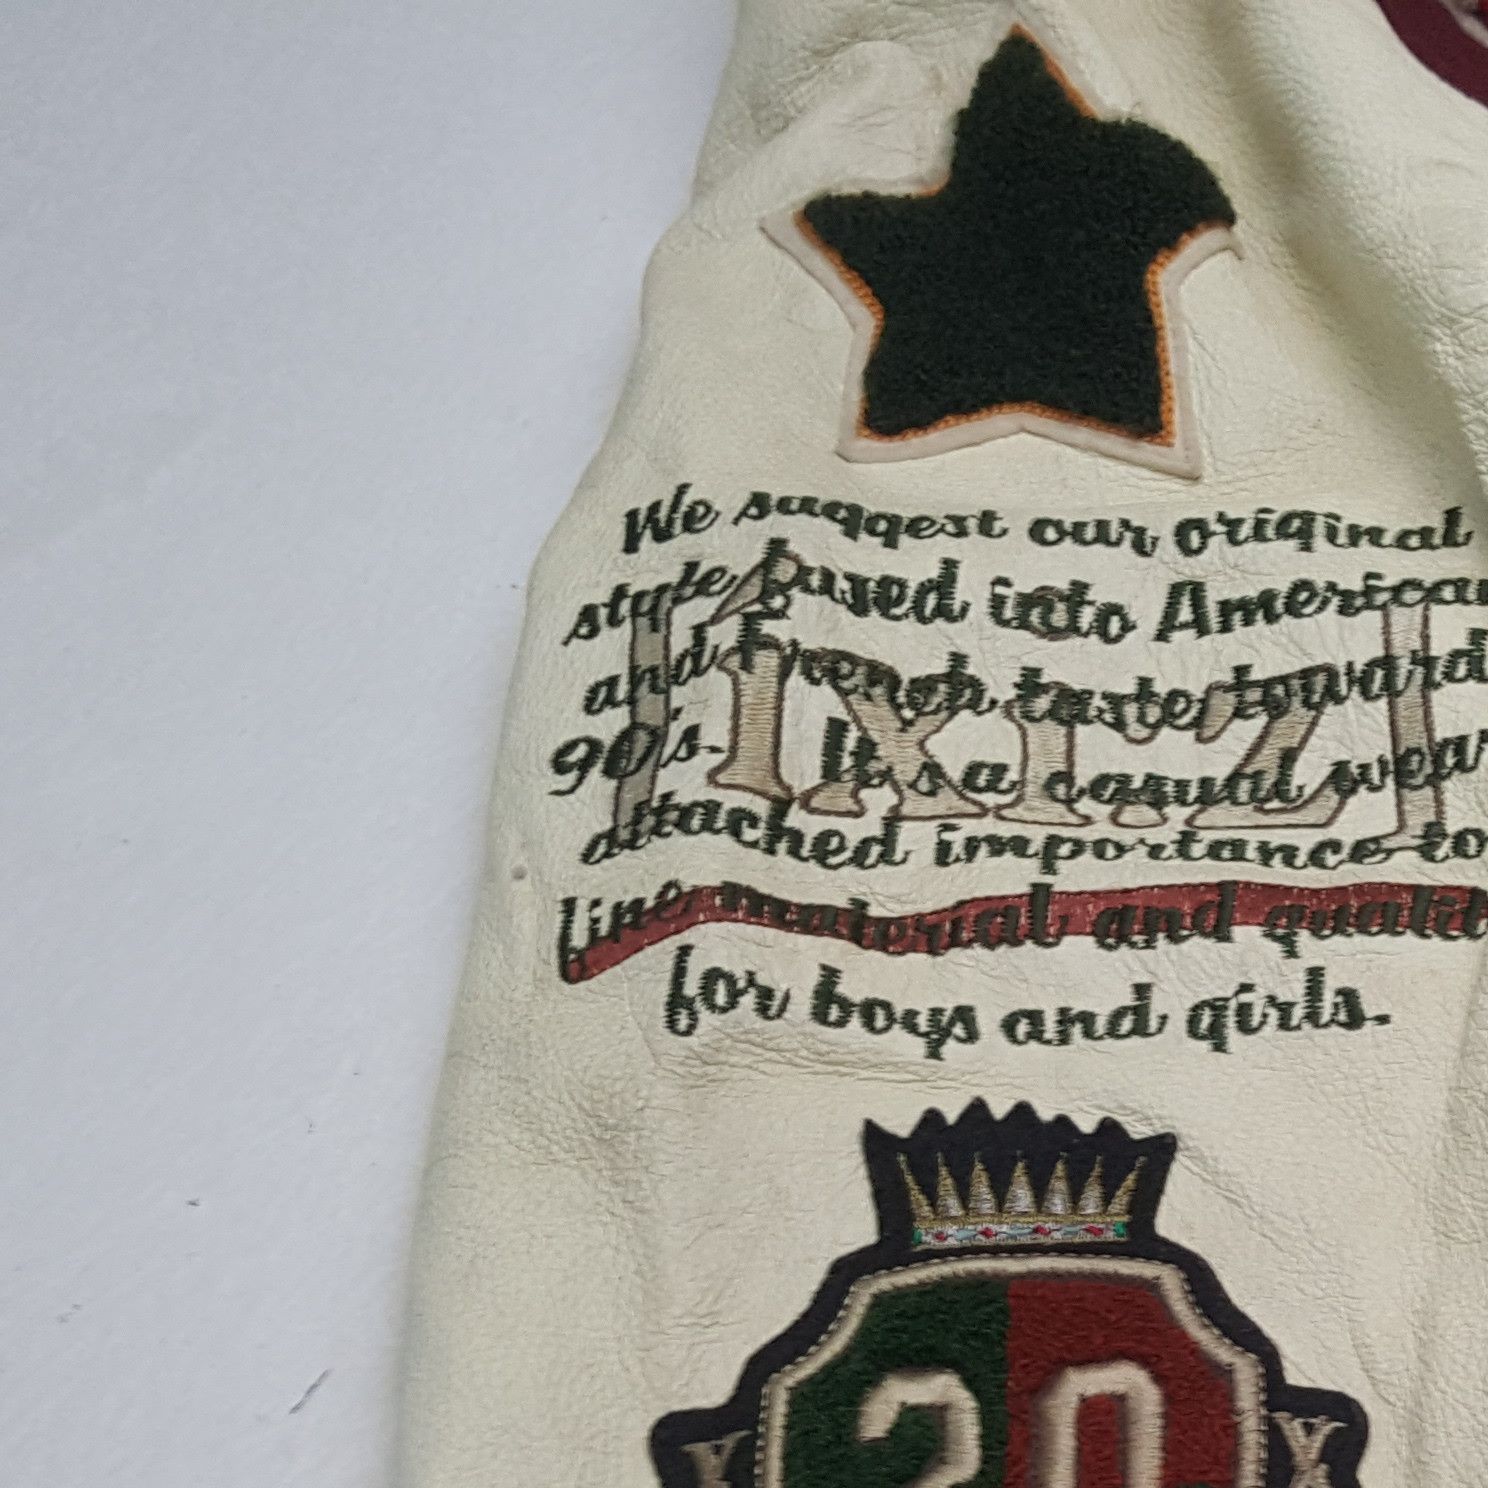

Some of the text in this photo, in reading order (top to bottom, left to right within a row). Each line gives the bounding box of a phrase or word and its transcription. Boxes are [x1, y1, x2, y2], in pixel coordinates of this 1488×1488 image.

[623, 483, 1473, 556] We suggest our original
[560, 559, 738, 647] style
[760, 538, 971, 625] based
[988, 575, 1137, 644] into
[583, 621, 719, 715] and
[737, 610, 998, 724] French
[1012, 665, 1203, 731] taste
[1044, 745, 1305, 806] casual
[578, 789, 911, 870] attached
[934, 820, 1402, 876] importance
[720, 881, 1067, 956] material
[1093, 879, 1236, 951] and
[664, 944, 791, 1036] for
[811, 963, 981, 1061] boys
[1000, 982, 1168, 1047] and
